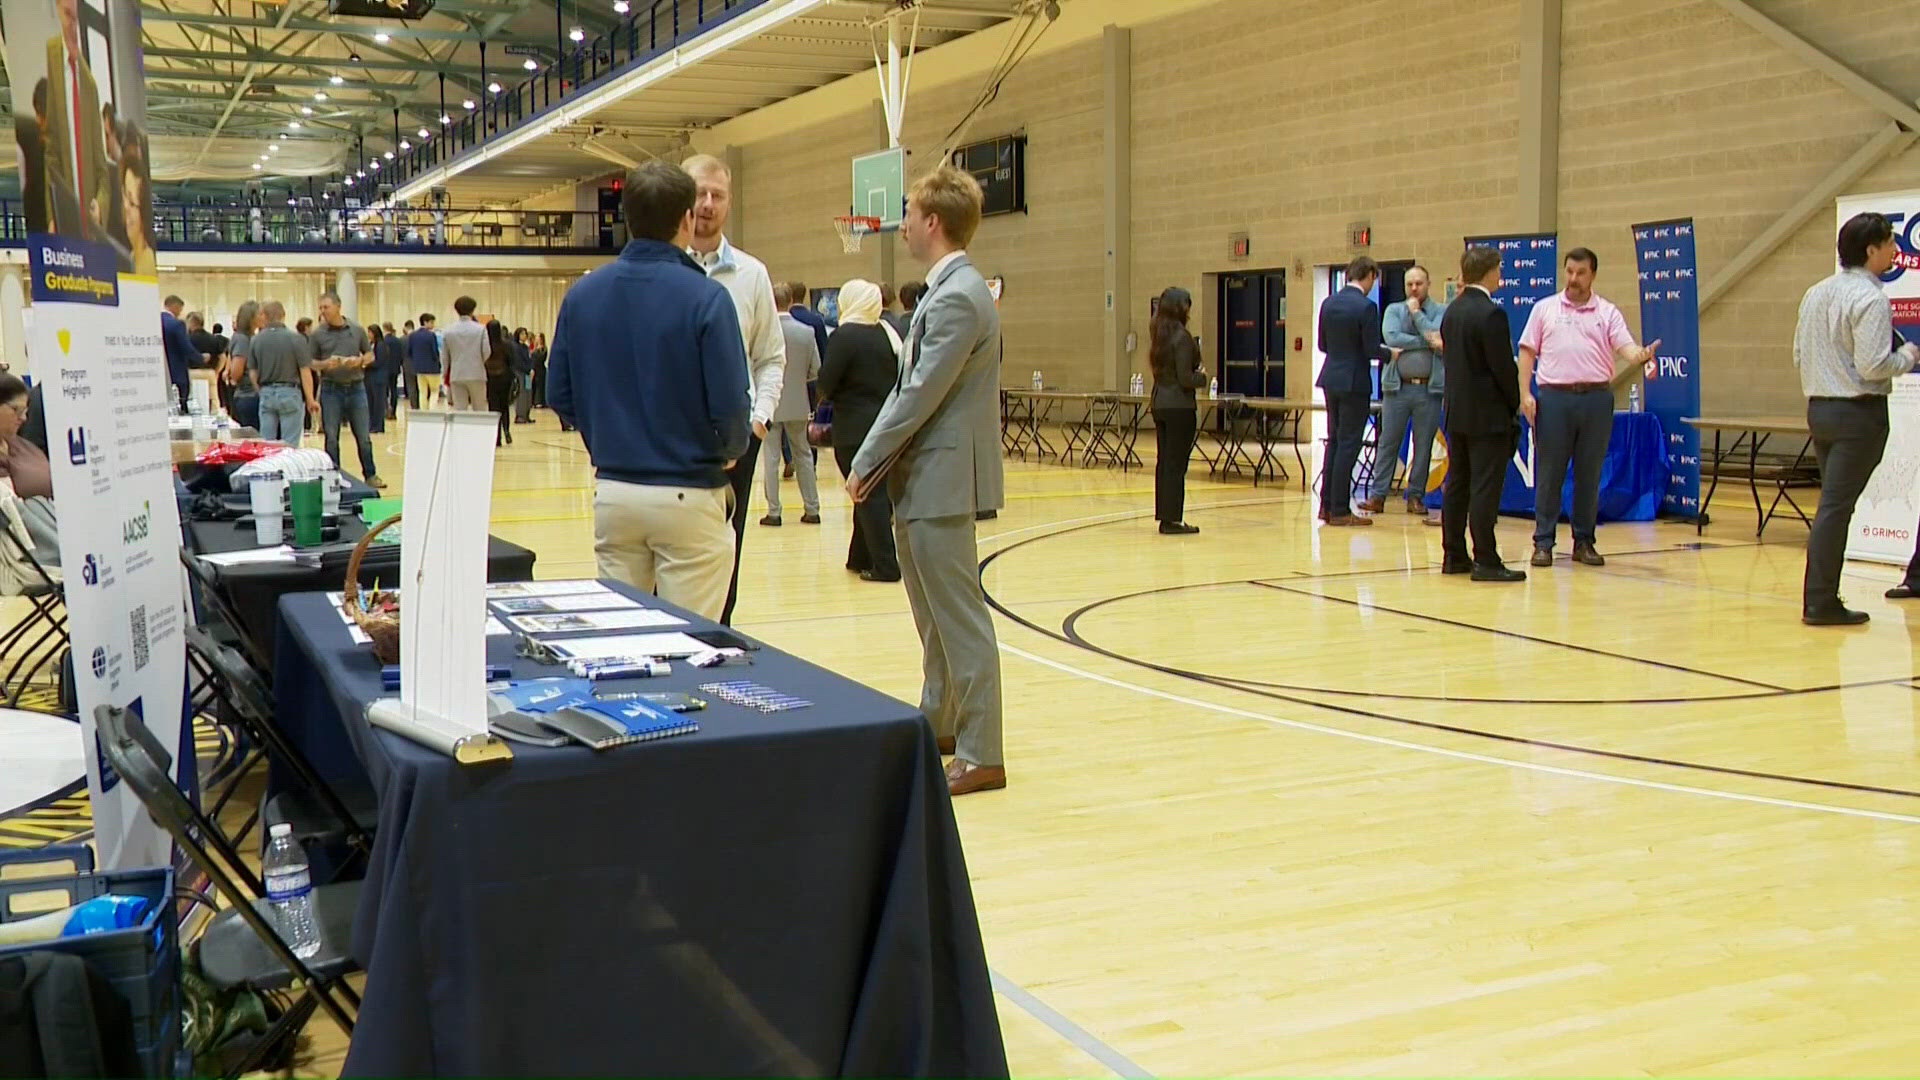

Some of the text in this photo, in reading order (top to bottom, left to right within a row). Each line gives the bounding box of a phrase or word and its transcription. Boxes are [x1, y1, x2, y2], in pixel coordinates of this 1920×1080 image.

[1660, 228, 1670, 236] PNC
[1680, 226, 1692, 234] PNC
[1506, 241, 1521, 249] PNC
[1538, 240, 1554, 249] PNC
[42, 246, 85, 268] Business
[1648, 248, 1680, 258] PNC PNC
[1521, 259, 1537, 267] PNC
[1892, 252, 1919, 268] ARS
[1660, 270, 1670, 278] PNC
[1680, 268, 1693, 277] PNC
[45, 271, 88, 291] Graduate
[1505, 278, 1553, 287] PNC PNC
[1520, 297, 1536, 305] PNC
[1658, 356, 1688, 377] PNC
[1685, 456, 1698, 464] PNC
[123, 514, 148, 546] AACSB
[1871, 527, 1909, 539] GRIMCO
